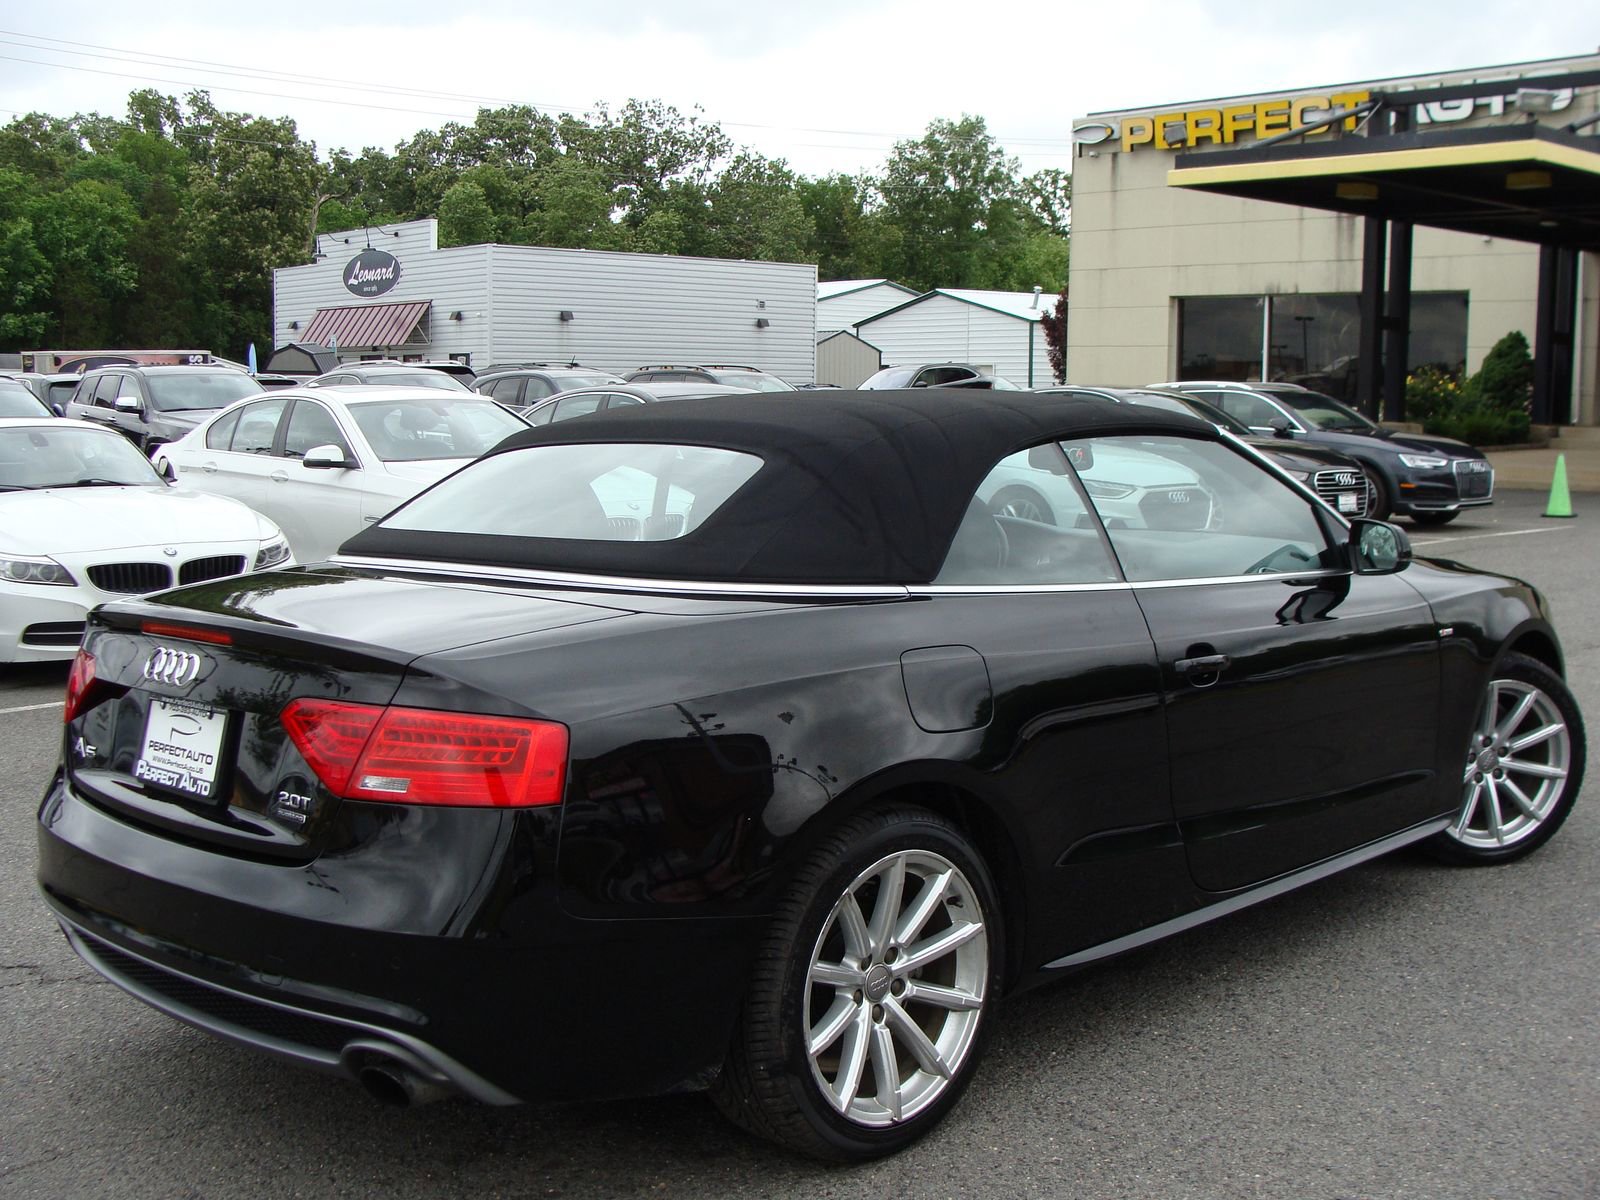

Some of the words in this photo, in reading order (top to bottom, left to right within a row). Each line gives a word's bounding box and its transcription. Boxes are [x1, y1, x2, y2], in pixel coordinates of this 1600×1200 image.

[1121, 91, 1370, 152] PERFECT
[347, 260, 396, 285] Leonard
[74, 736, 97, 758] A5
[135, 759, 181, 787] PERFECT
[178, 771, 211, 796] AUTO
